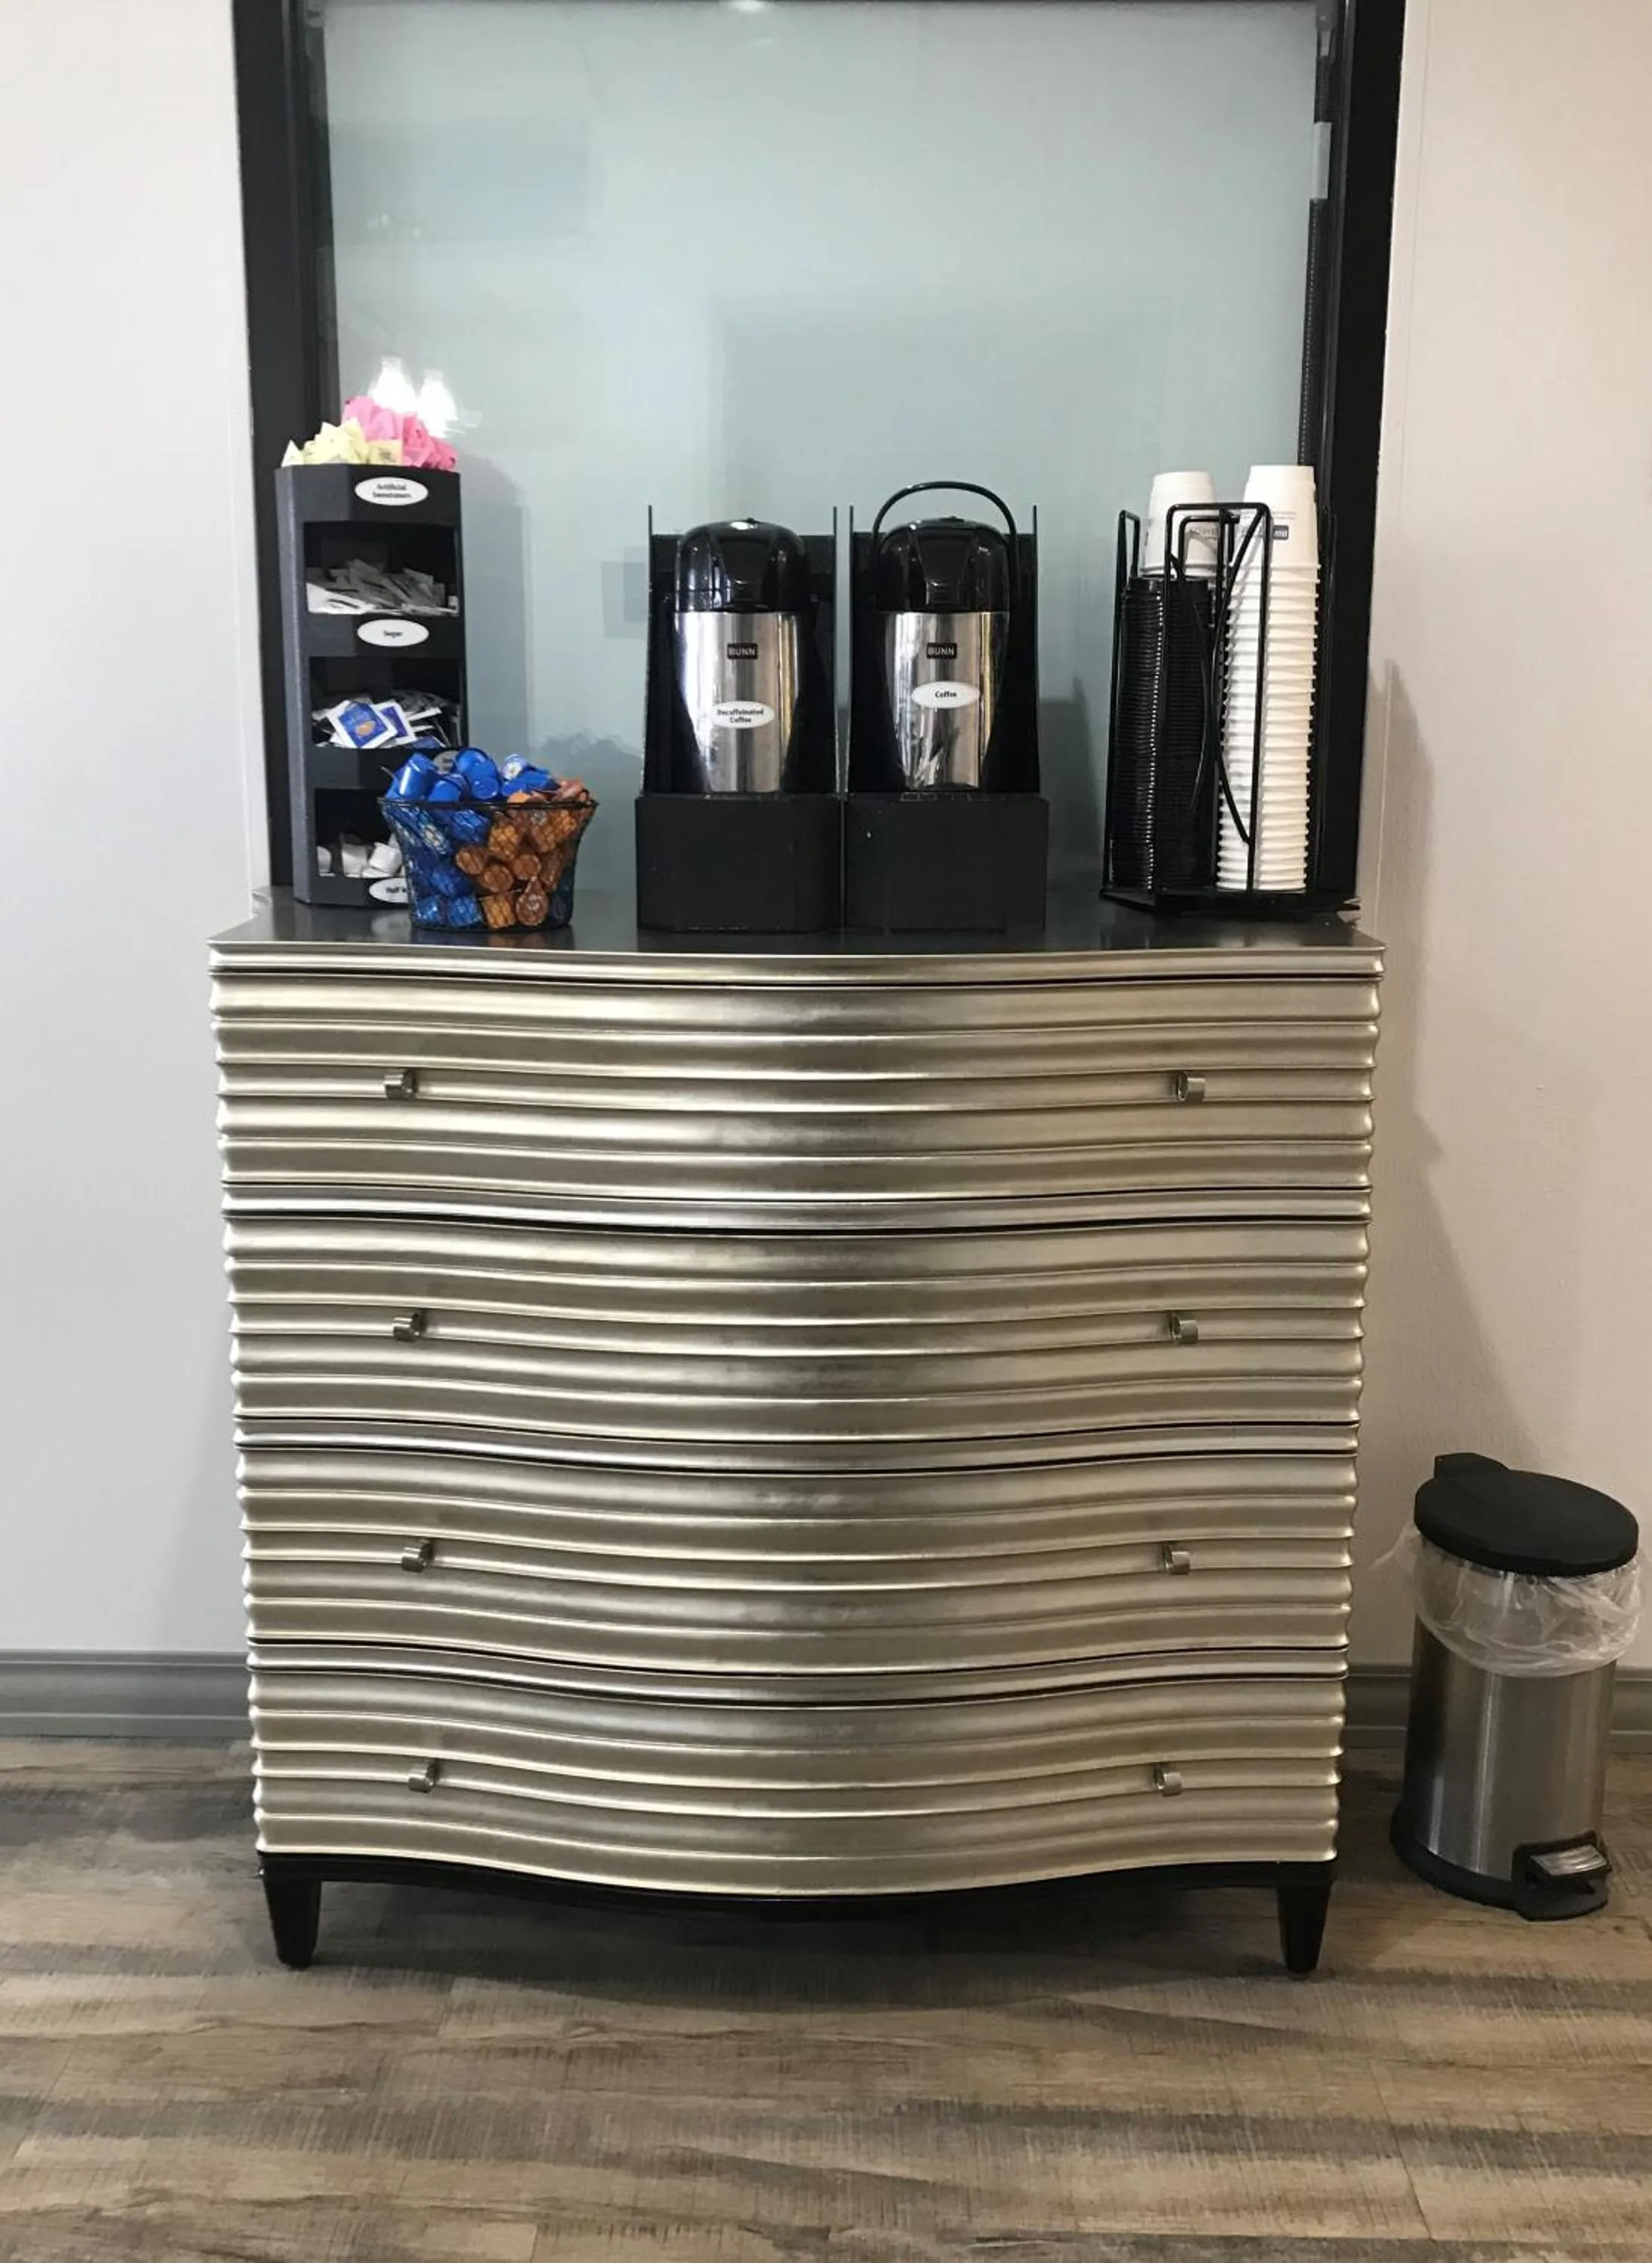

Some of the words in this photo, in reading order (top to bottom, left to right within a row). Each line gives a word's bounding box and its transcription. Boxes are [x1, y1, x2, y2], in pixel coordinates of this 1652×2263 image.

[728, 647, 755, 656] BUNN
[927, 646, 955, 656] BUNN
[935, 690, 957, 699] Coffee
[717, 708, 764, 716] Decaffeinated
